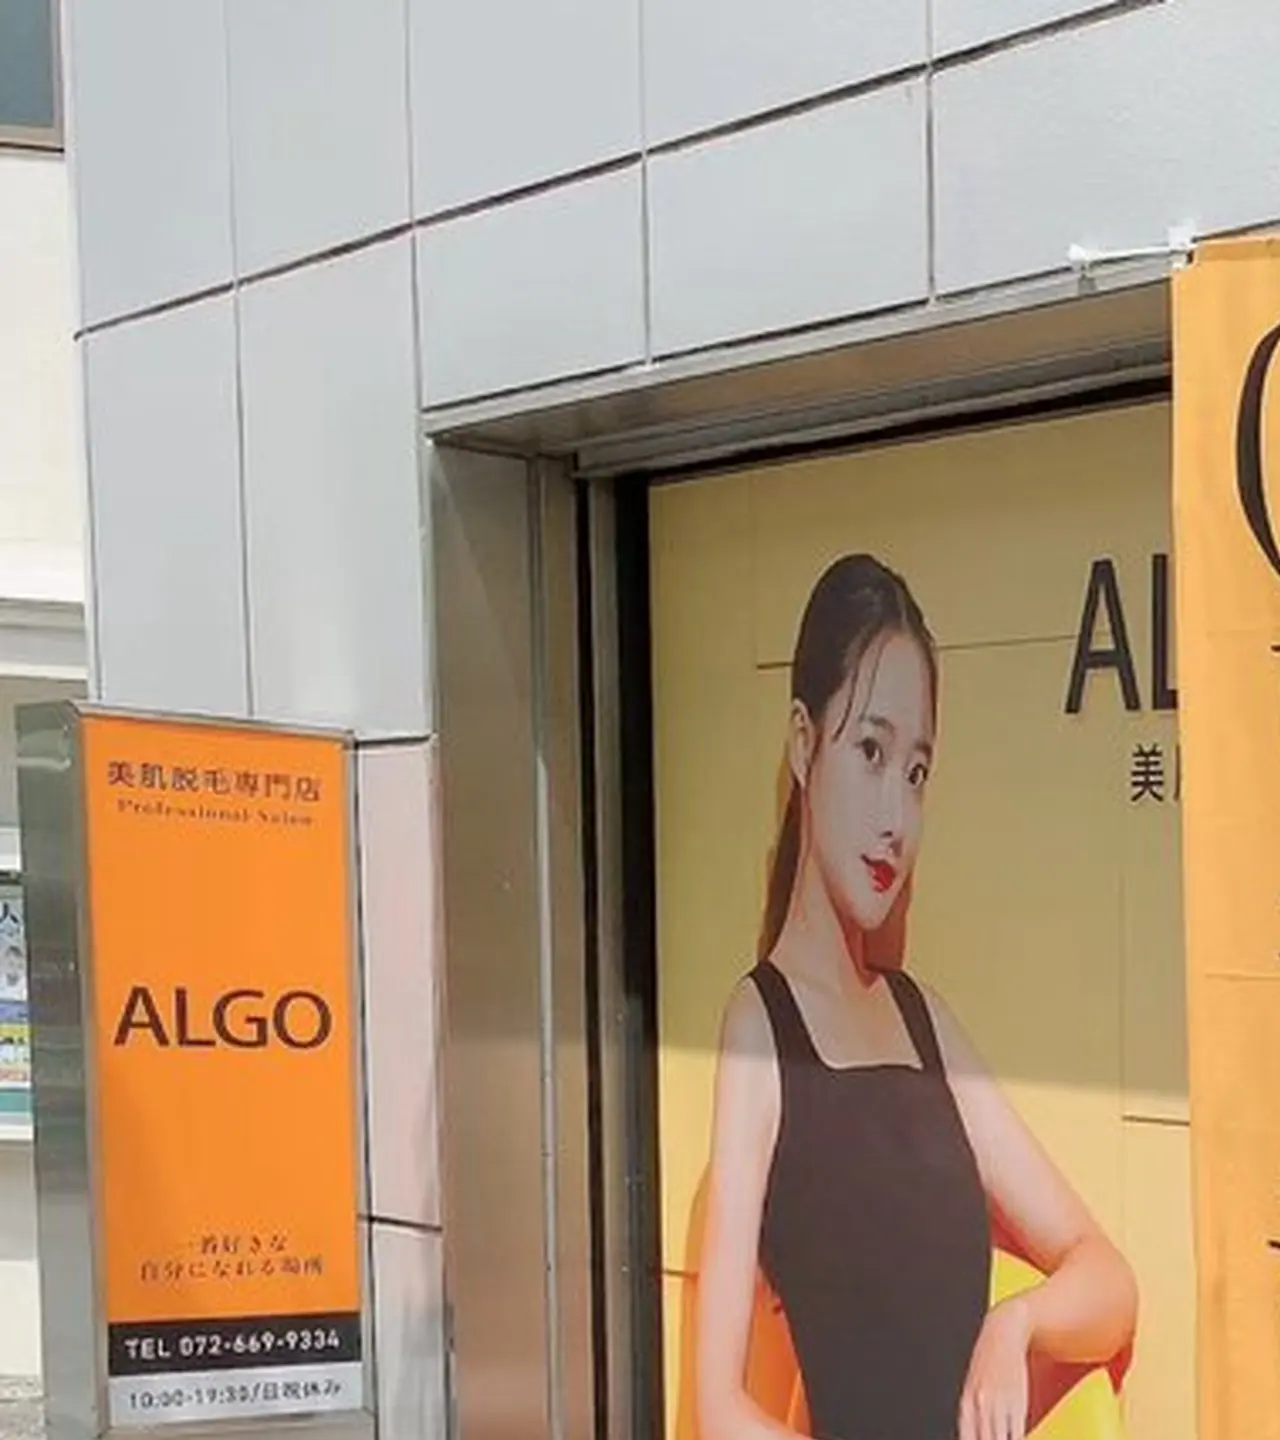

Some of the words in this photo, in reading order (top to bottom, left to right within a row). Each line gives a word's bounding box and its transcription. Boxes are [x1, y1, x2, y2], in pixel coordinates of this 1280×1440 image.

[107, 760, 322, 802] 美肌脱毛専門店
[1130, 743, 1181, 802] 美
[113, 986, 332, 1049] ALGO
[124, 1338, 171, 1360] TEL
